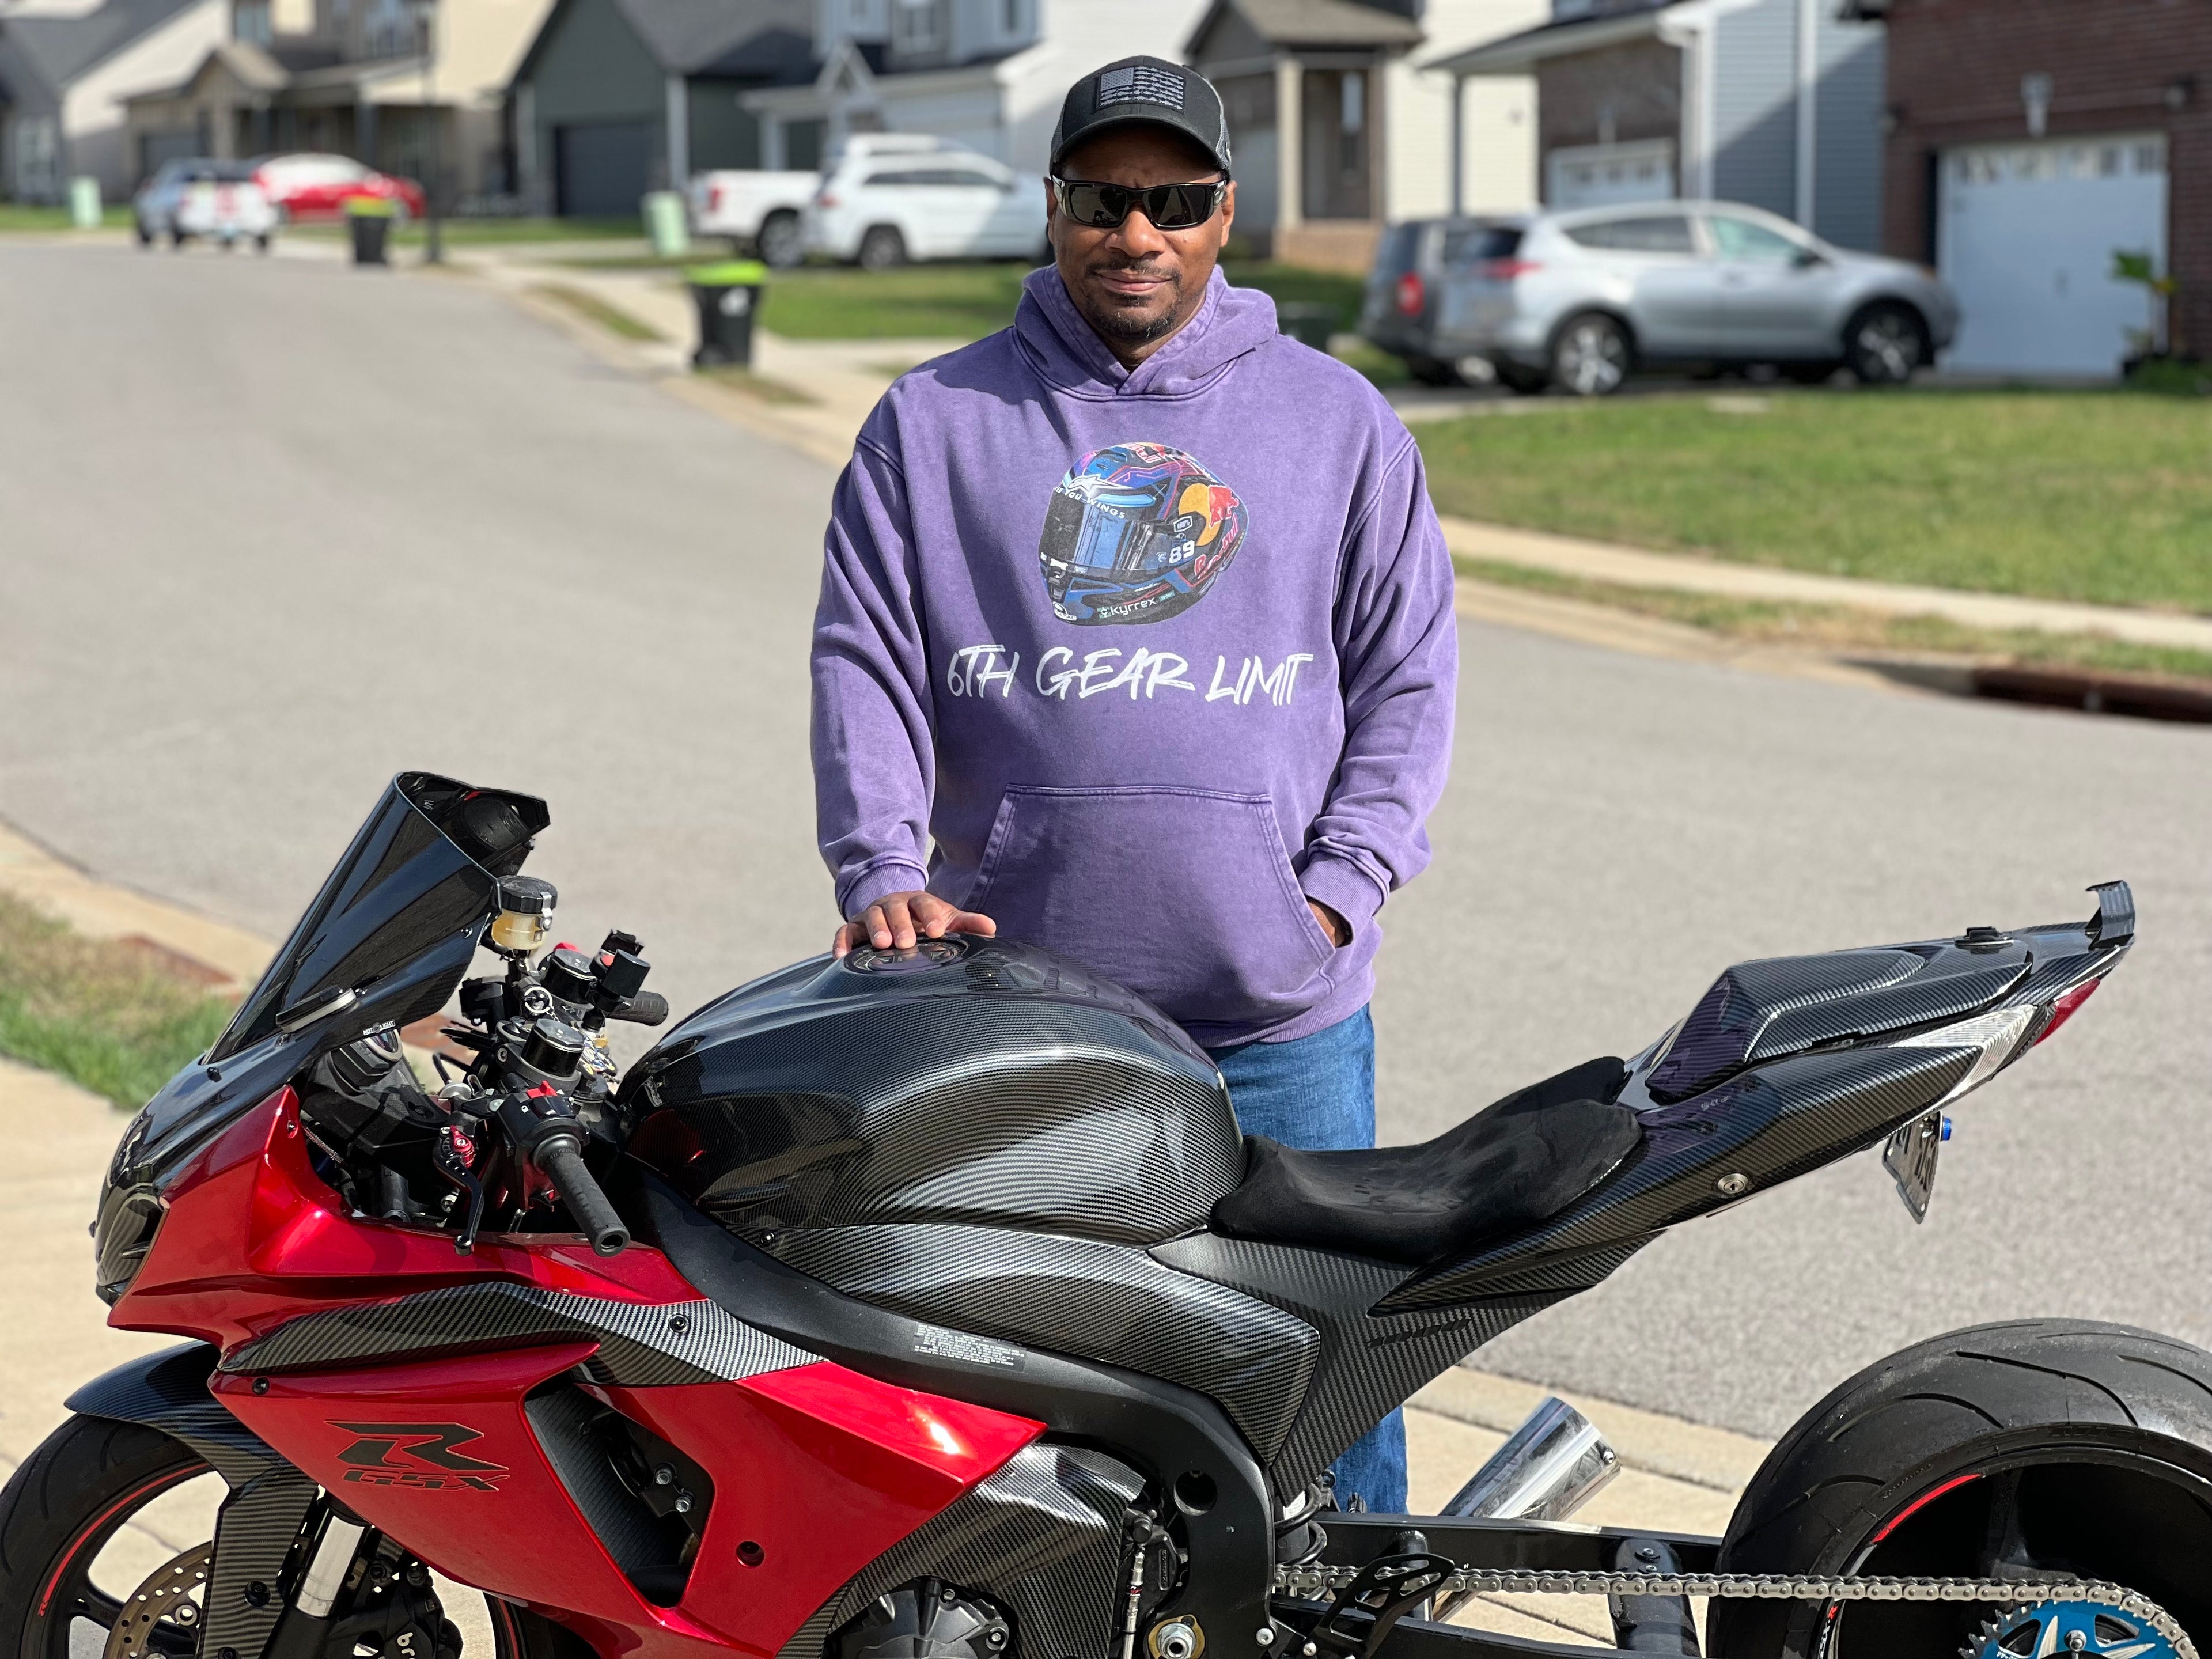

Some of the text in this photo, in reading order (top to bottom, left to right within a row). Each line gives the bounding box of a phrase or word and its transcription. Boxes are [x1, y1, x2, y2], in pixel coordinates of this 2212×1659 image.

[1086, 497, 1126, 518] WINGS
[1168, 540, 1195, 564] 89
[1110, 597, 1157, 616] kyrrex
[948, 644, 1314, 706] 6TH GEAR LIMIT
[342, 1468, 511, 1492] GSX
[397, 1632, 416, 1659] br
